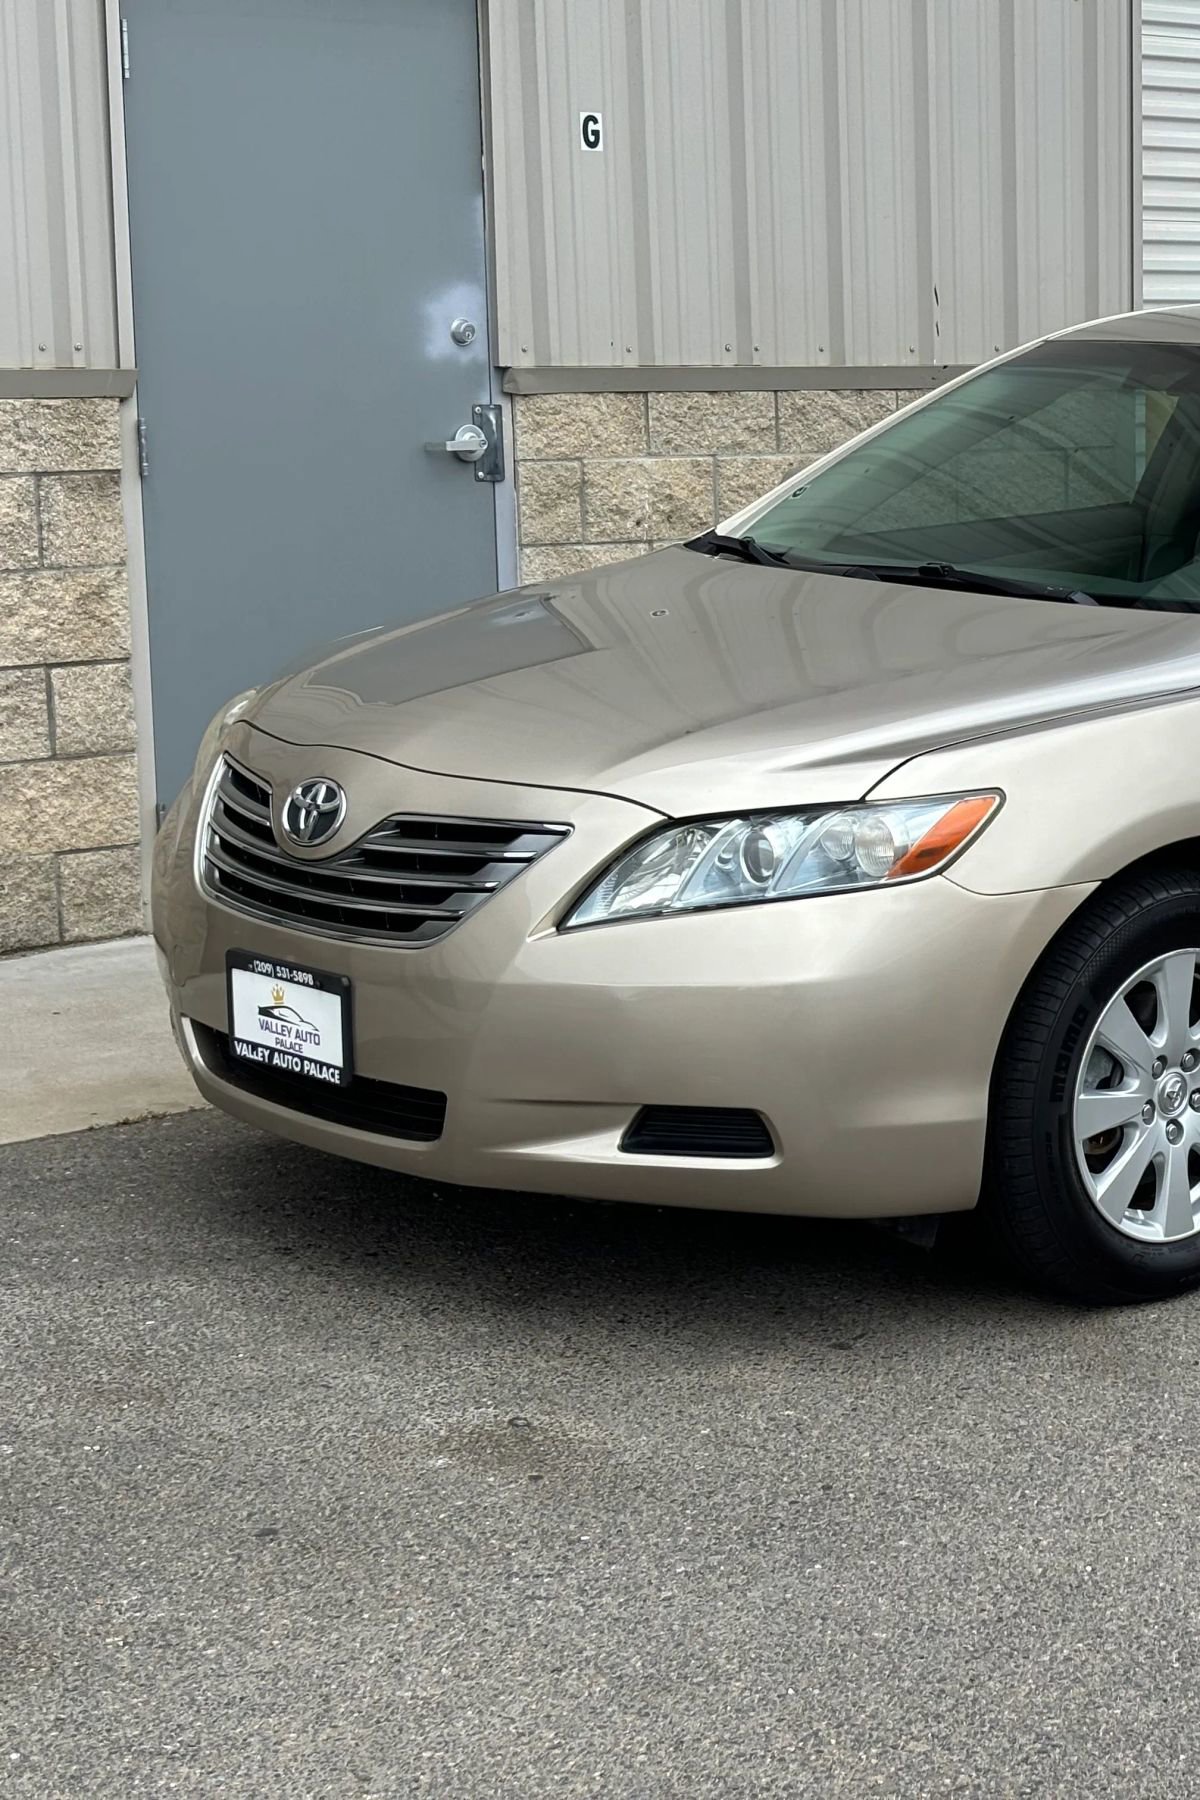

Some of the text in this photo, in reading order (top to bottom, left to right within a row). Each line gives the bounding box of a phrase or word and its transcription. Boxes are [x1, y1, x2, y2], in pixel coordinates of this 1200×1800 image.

[582, 114, 600, 149] G
[254, 960, 313, 985] (209) 531-5898
[259, 1018, 320, 1045] VALLEY AUTO
[275, 1037, 303, 1053] PALACE
[234, 1040, 341, 1084] VALLEY AUTO PALACE
